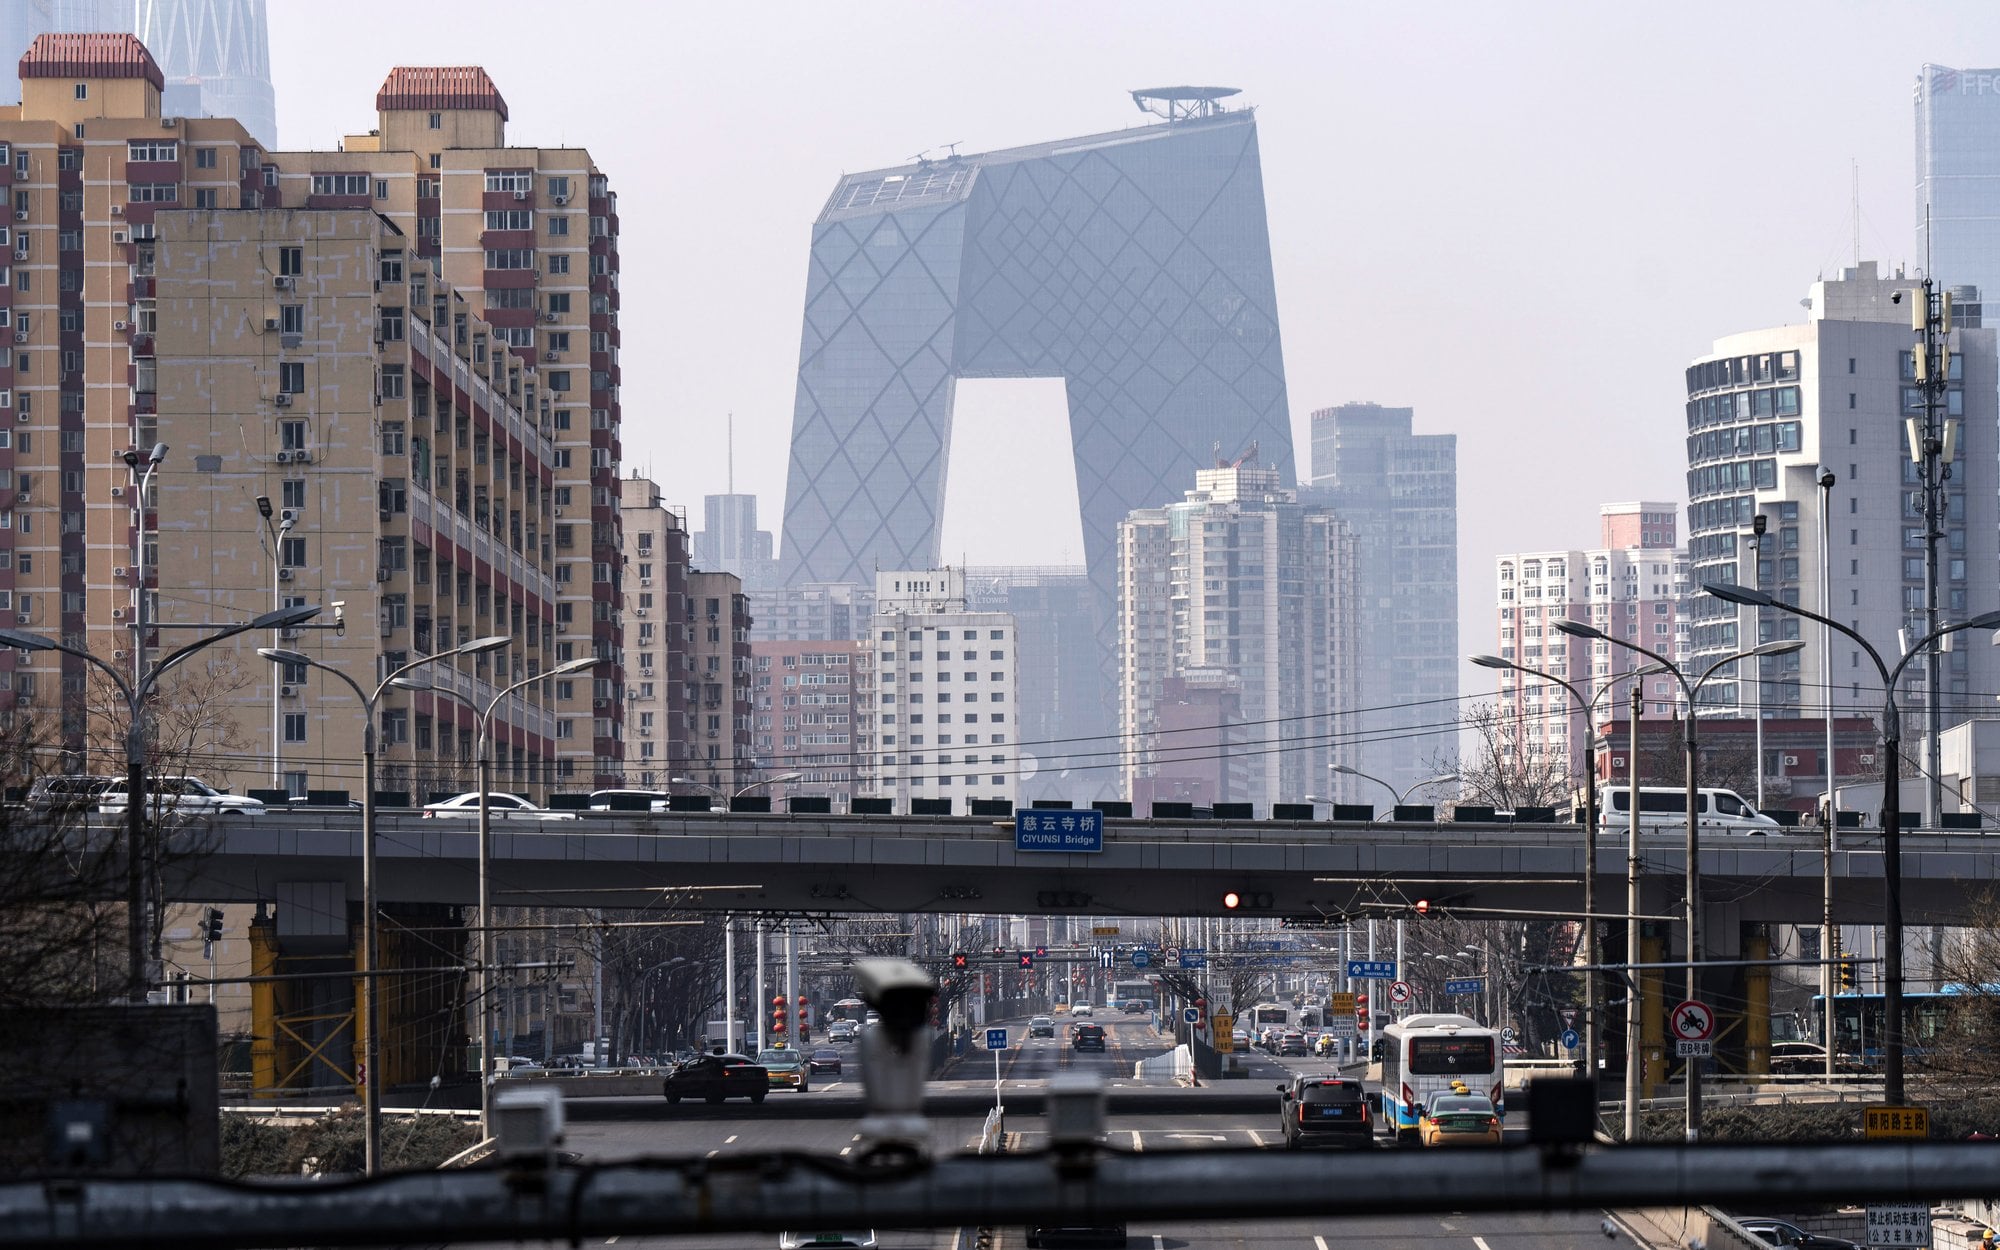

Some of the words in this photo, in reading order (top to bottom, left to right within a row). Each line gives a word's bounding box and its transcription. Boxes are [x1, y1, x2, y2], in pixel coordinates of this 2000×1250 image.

[1023, 816, 1095, 831] 慈云寺桥
[1022, 834, 1060, 843] CIYUNSI
[1065, 834, 1094, 845] Bridge
[1503, 1030, 1512, 1039] 40
[1680, 1042, 1709, 1054] 京B号牌
[1868, 1113, 1924, 1130] 朝阳路主路
[1869, 1211, 1927, 1226] 禁止机动车通行
[1868, 1228, 1928, 1244] (公交车除外)
